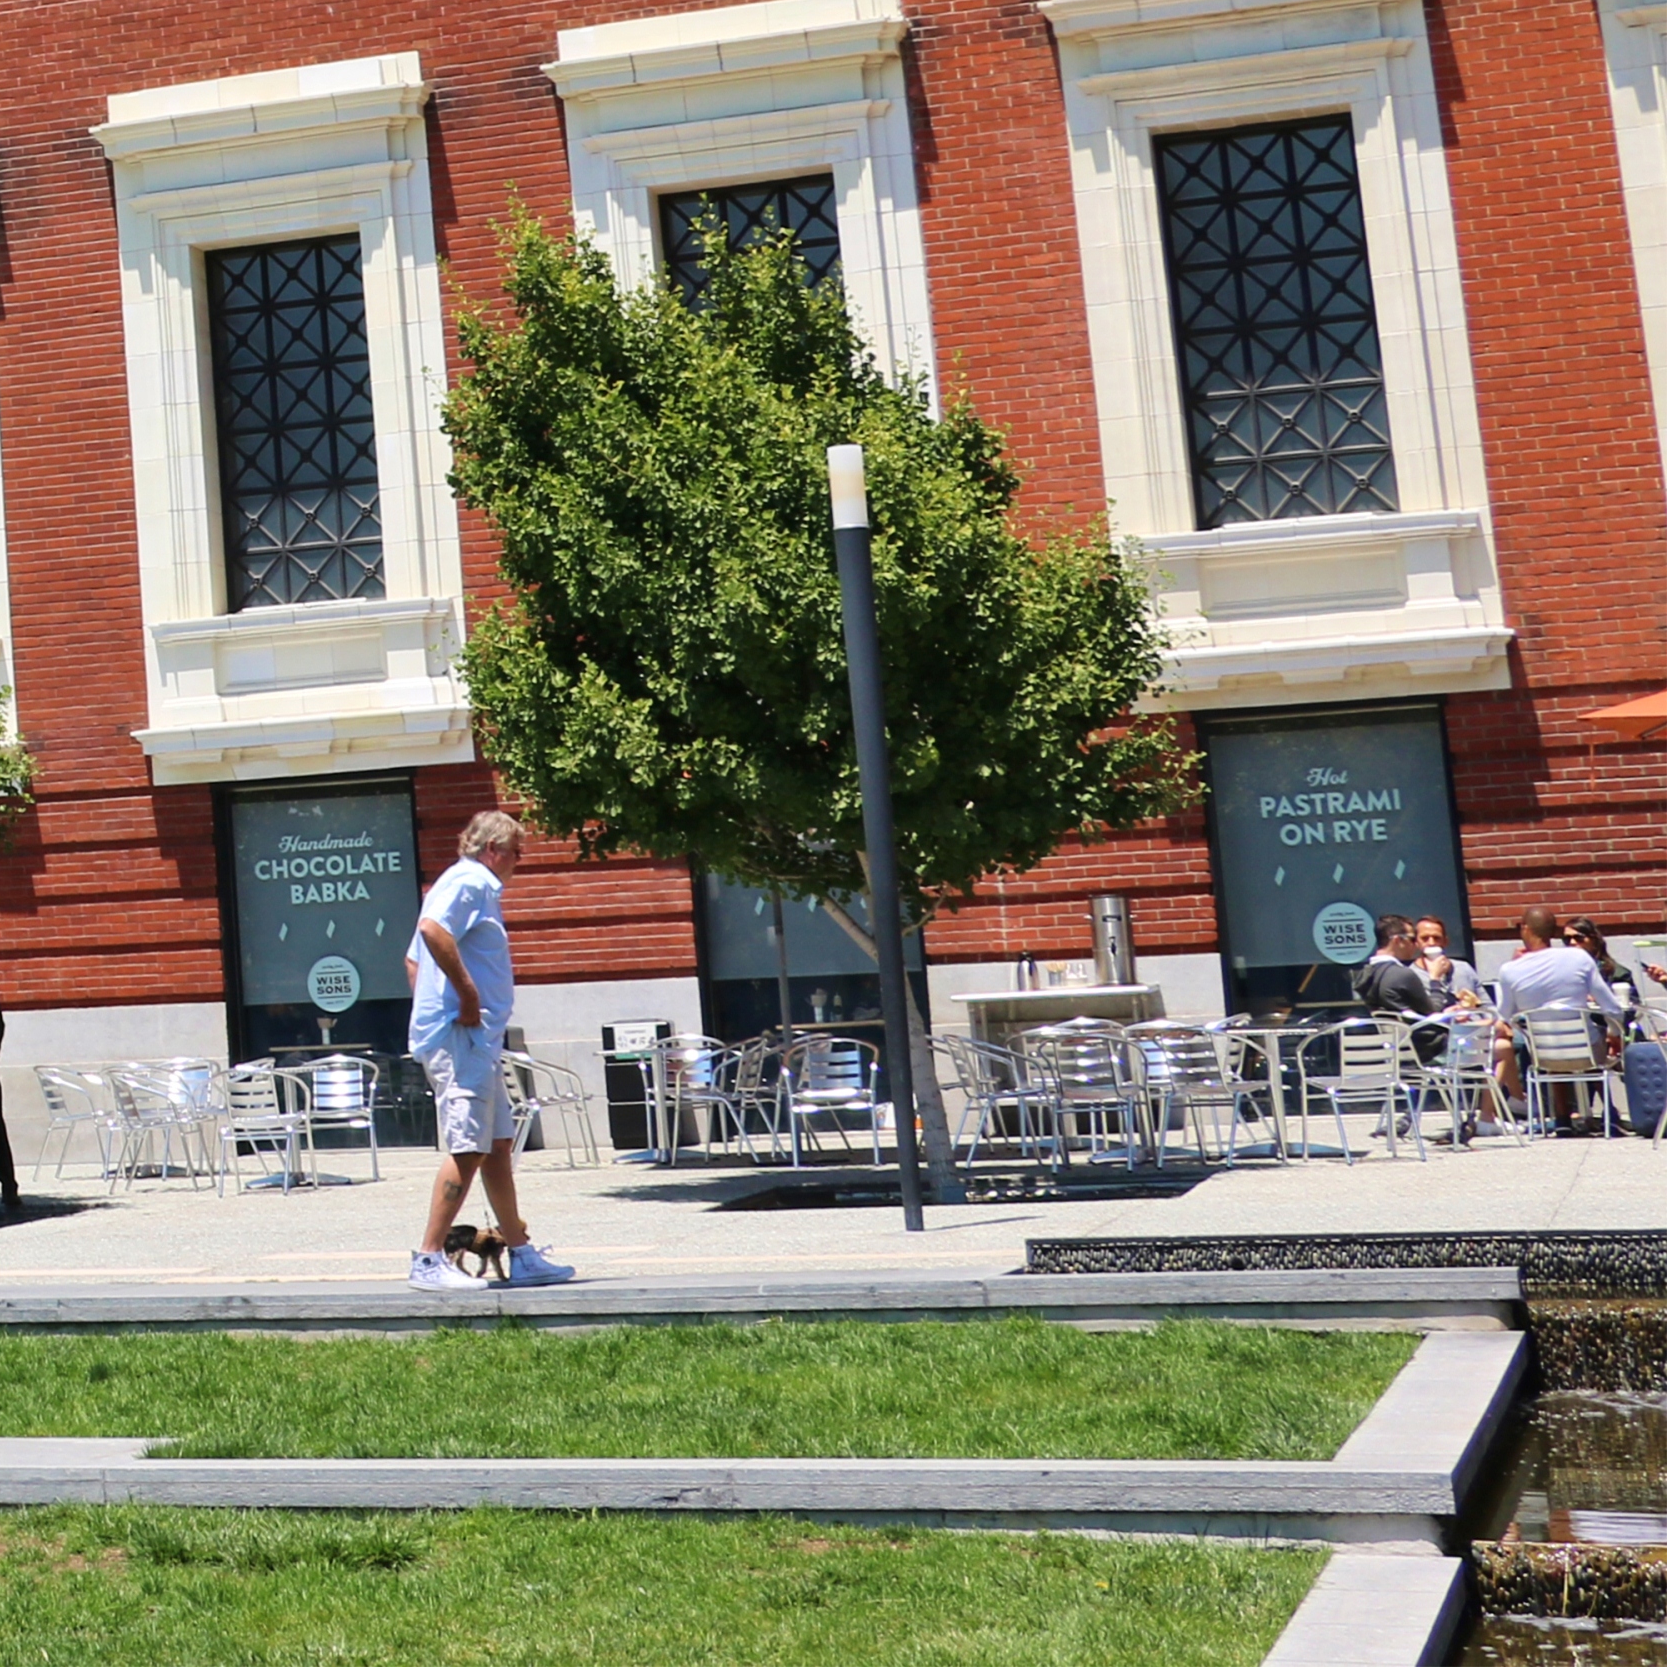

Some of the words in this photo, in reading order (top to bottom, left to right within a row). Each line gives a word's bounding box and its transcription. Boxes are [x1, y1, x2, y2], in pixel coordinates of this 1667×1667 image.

[1306, 767, 1349, 787] Hot
[1260, 788, 1401, 818] PASTRAMI
[278, 830, 374, 853] Handmade
[1279, 822, 1325, 846] ON
[1333, 819, 1388, 843] RYE
[254, 852, 402, 880] CHOCOLATE
[290, 880, 370, 904] BABKA
[1323, 923, 1365, 934] WISE
[1324, 934, 1366, 945] SONS
[316, 974, 350, 986] WISE
[317, 985, 352, 995] SONS
